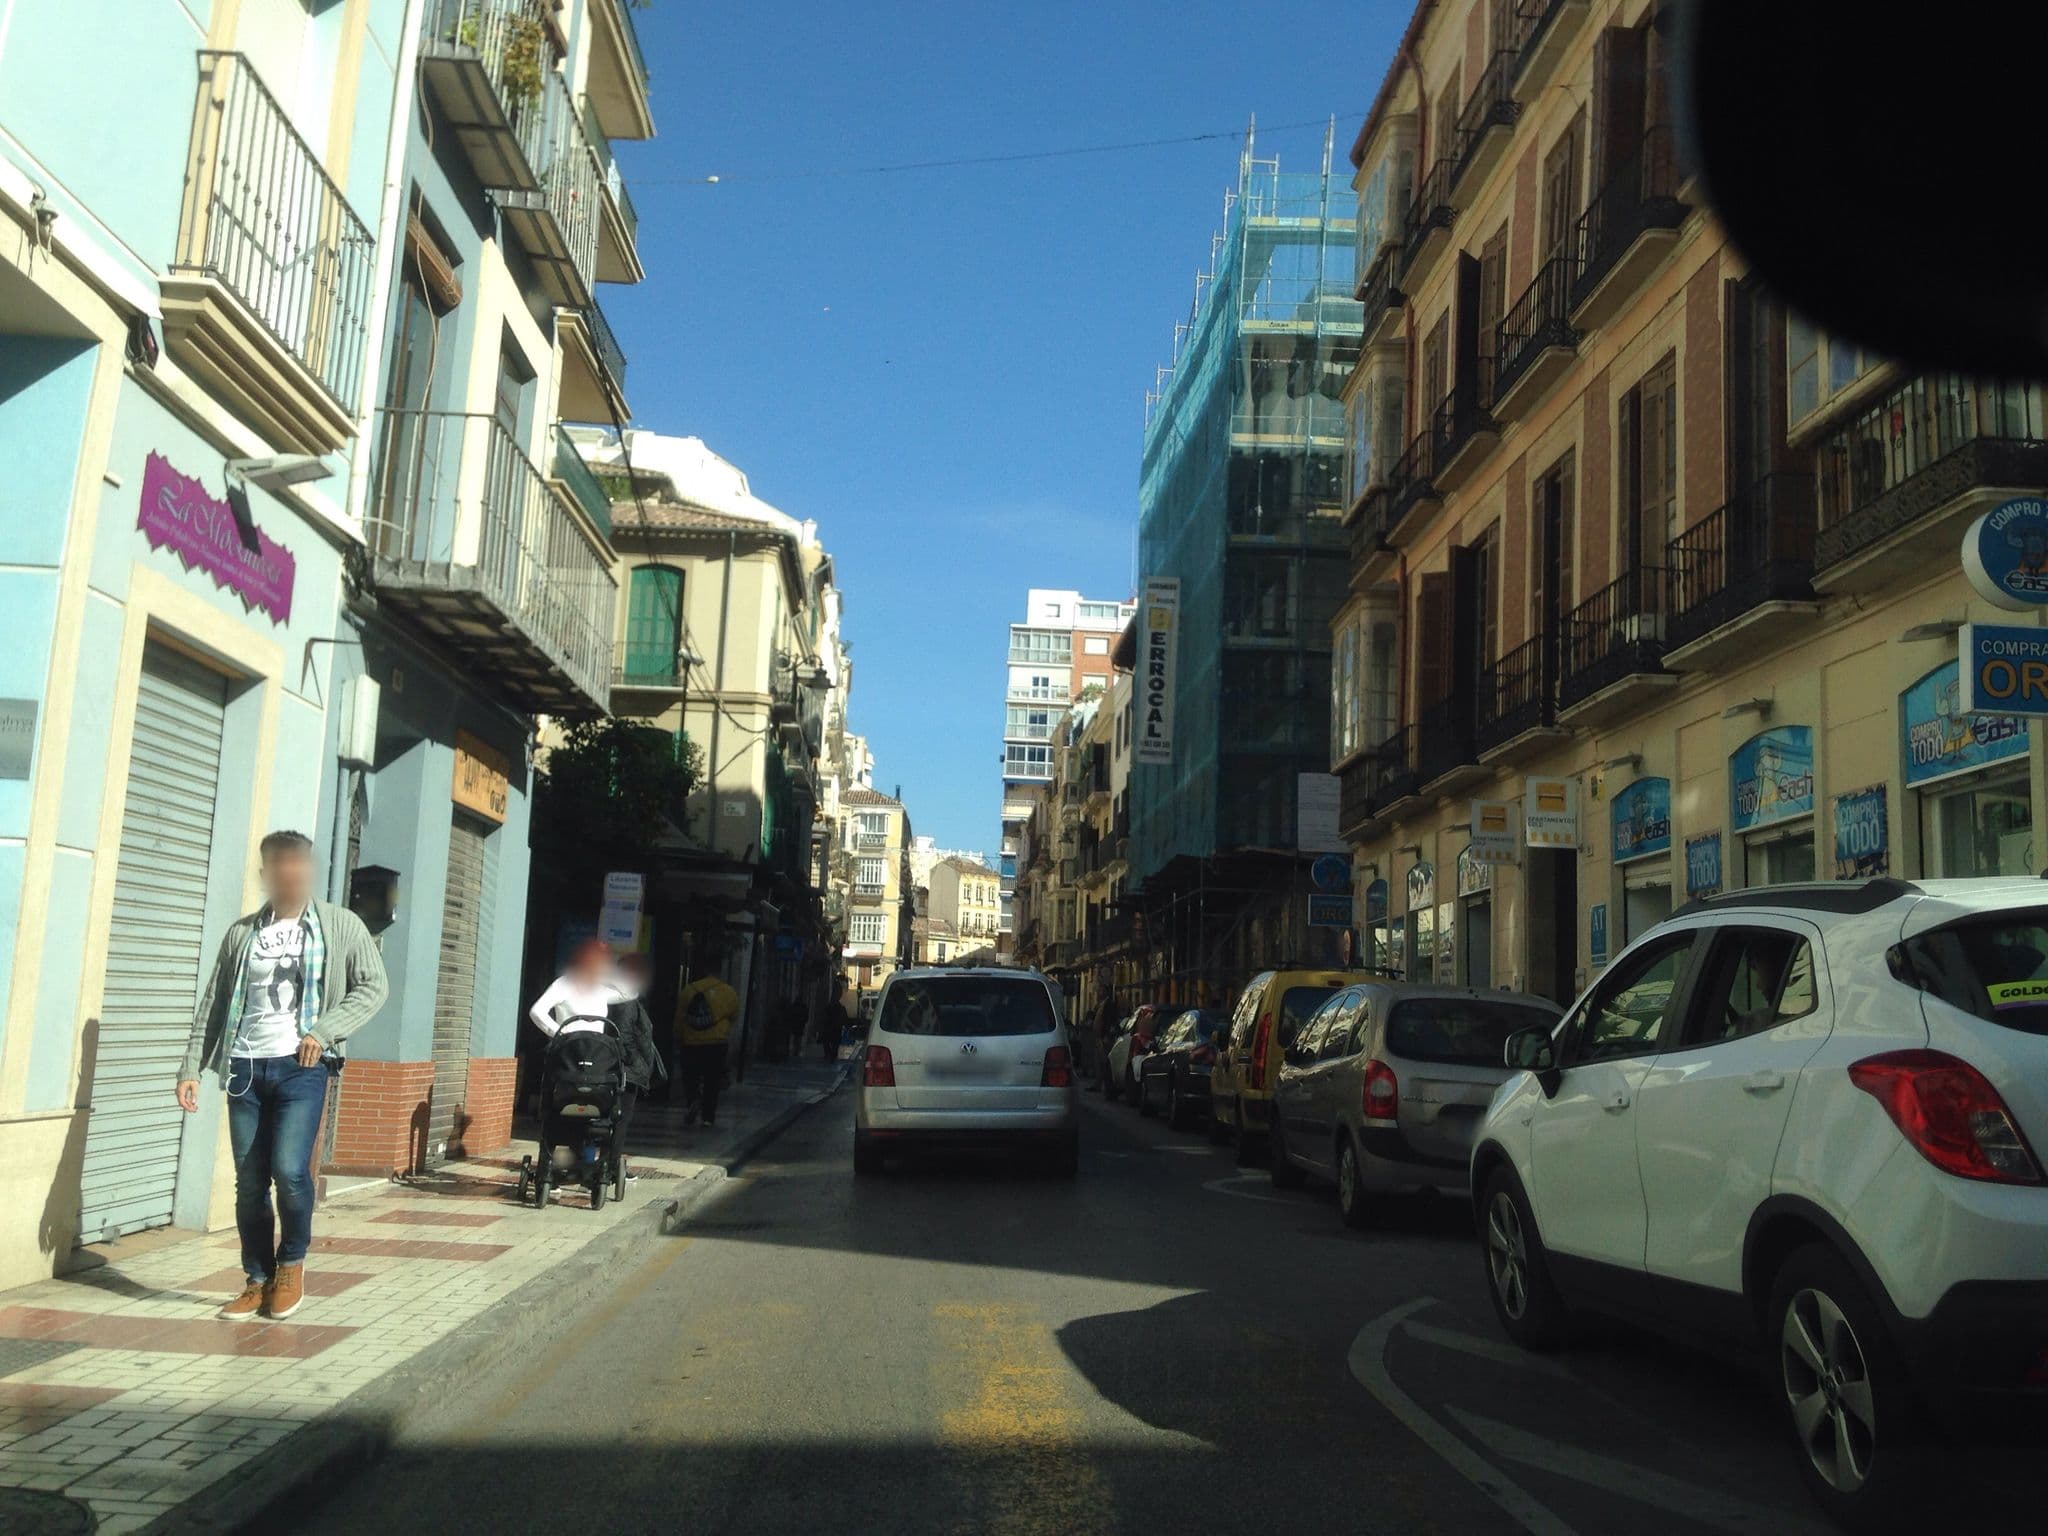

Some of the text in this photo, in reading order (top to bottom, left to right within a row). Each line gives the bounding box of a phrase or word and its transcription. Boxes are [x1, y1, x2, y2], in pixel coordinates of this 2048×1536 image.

[1989, 501, 2041, 530] COMPRO
[1147, 631, 1166, 738] ERROCAL
[1910, 719, 1943, 742] COMPRO
[1911, 735, 1944, 766] TODO
[1738, 793, 1760, 816] TODO
[1840, 799, 1879, 825] COMPRO
[1840, 818, 1880, 856] TODO
[1690, 856, 1717, 888] TODO
